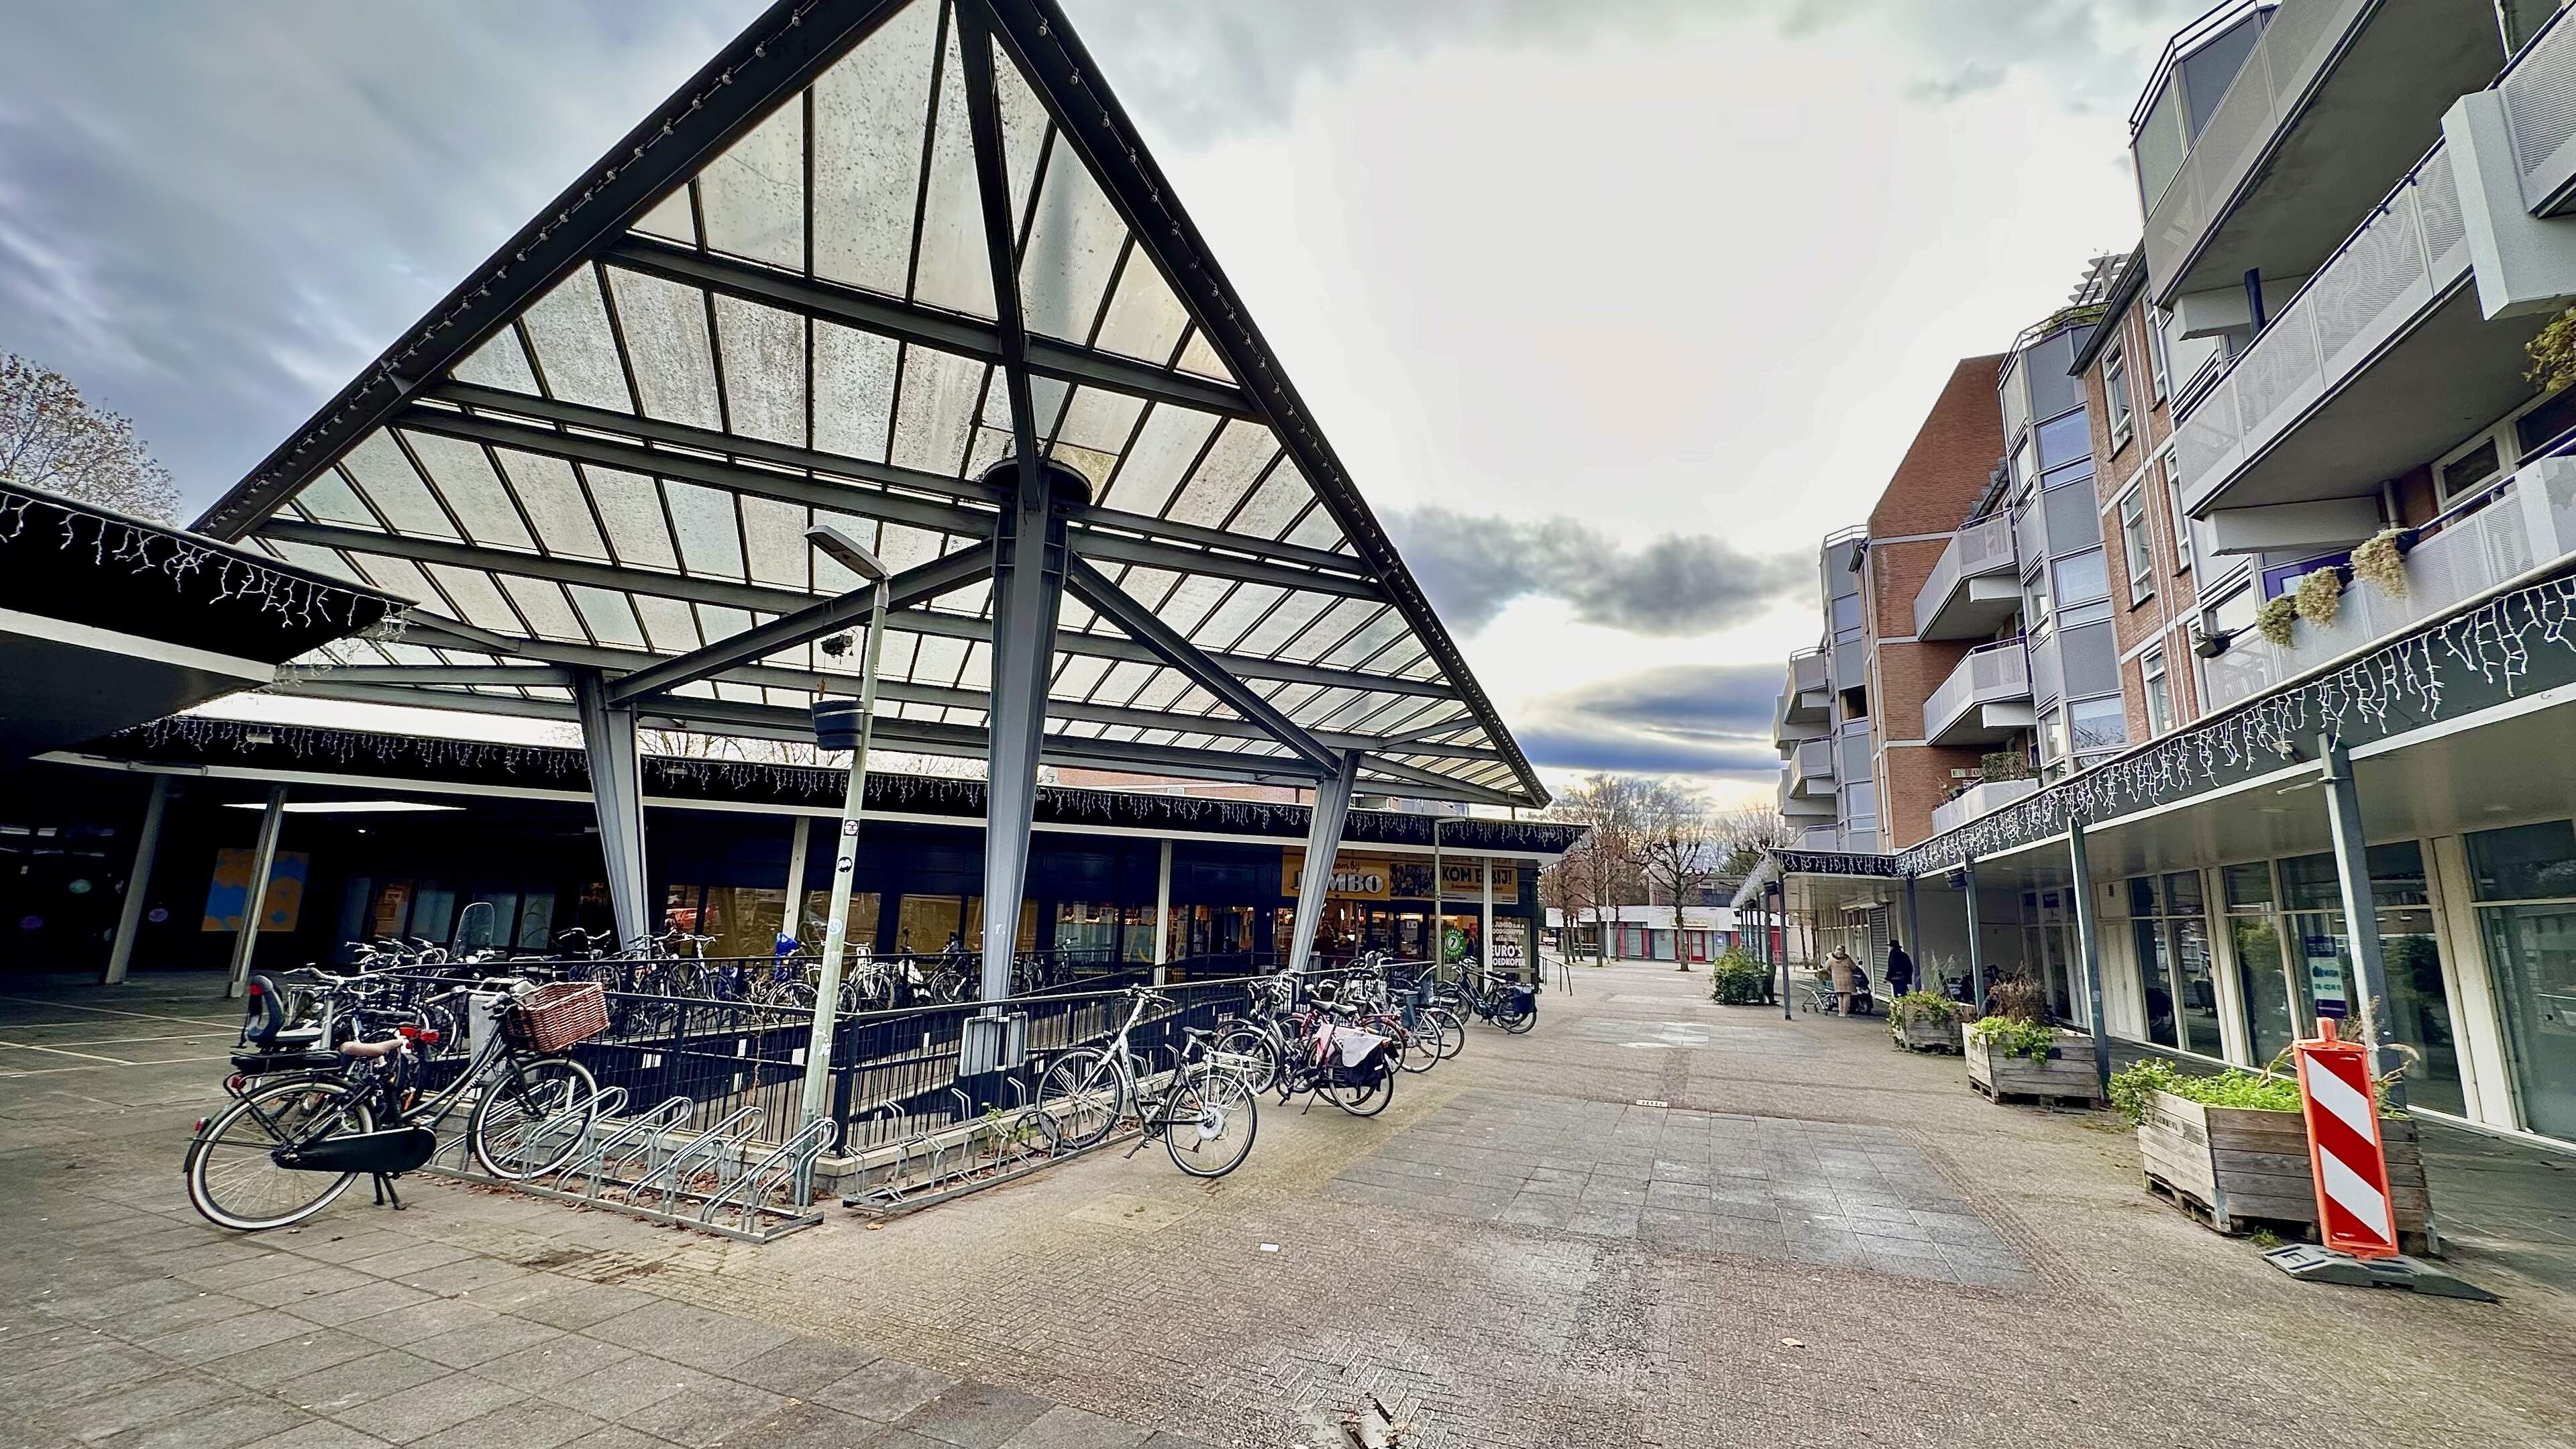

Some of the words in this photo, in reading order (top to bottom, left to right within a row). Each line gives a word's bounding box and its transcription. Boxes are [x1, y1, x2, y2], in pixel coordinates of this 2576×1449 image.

[1442, 867, 1472, 881] KOM
[1291, 871, 1383, 893] JMBO
[1451, 937, 1456, 947] 7
[1493, 957, 1525, 966] OEDKOPER
